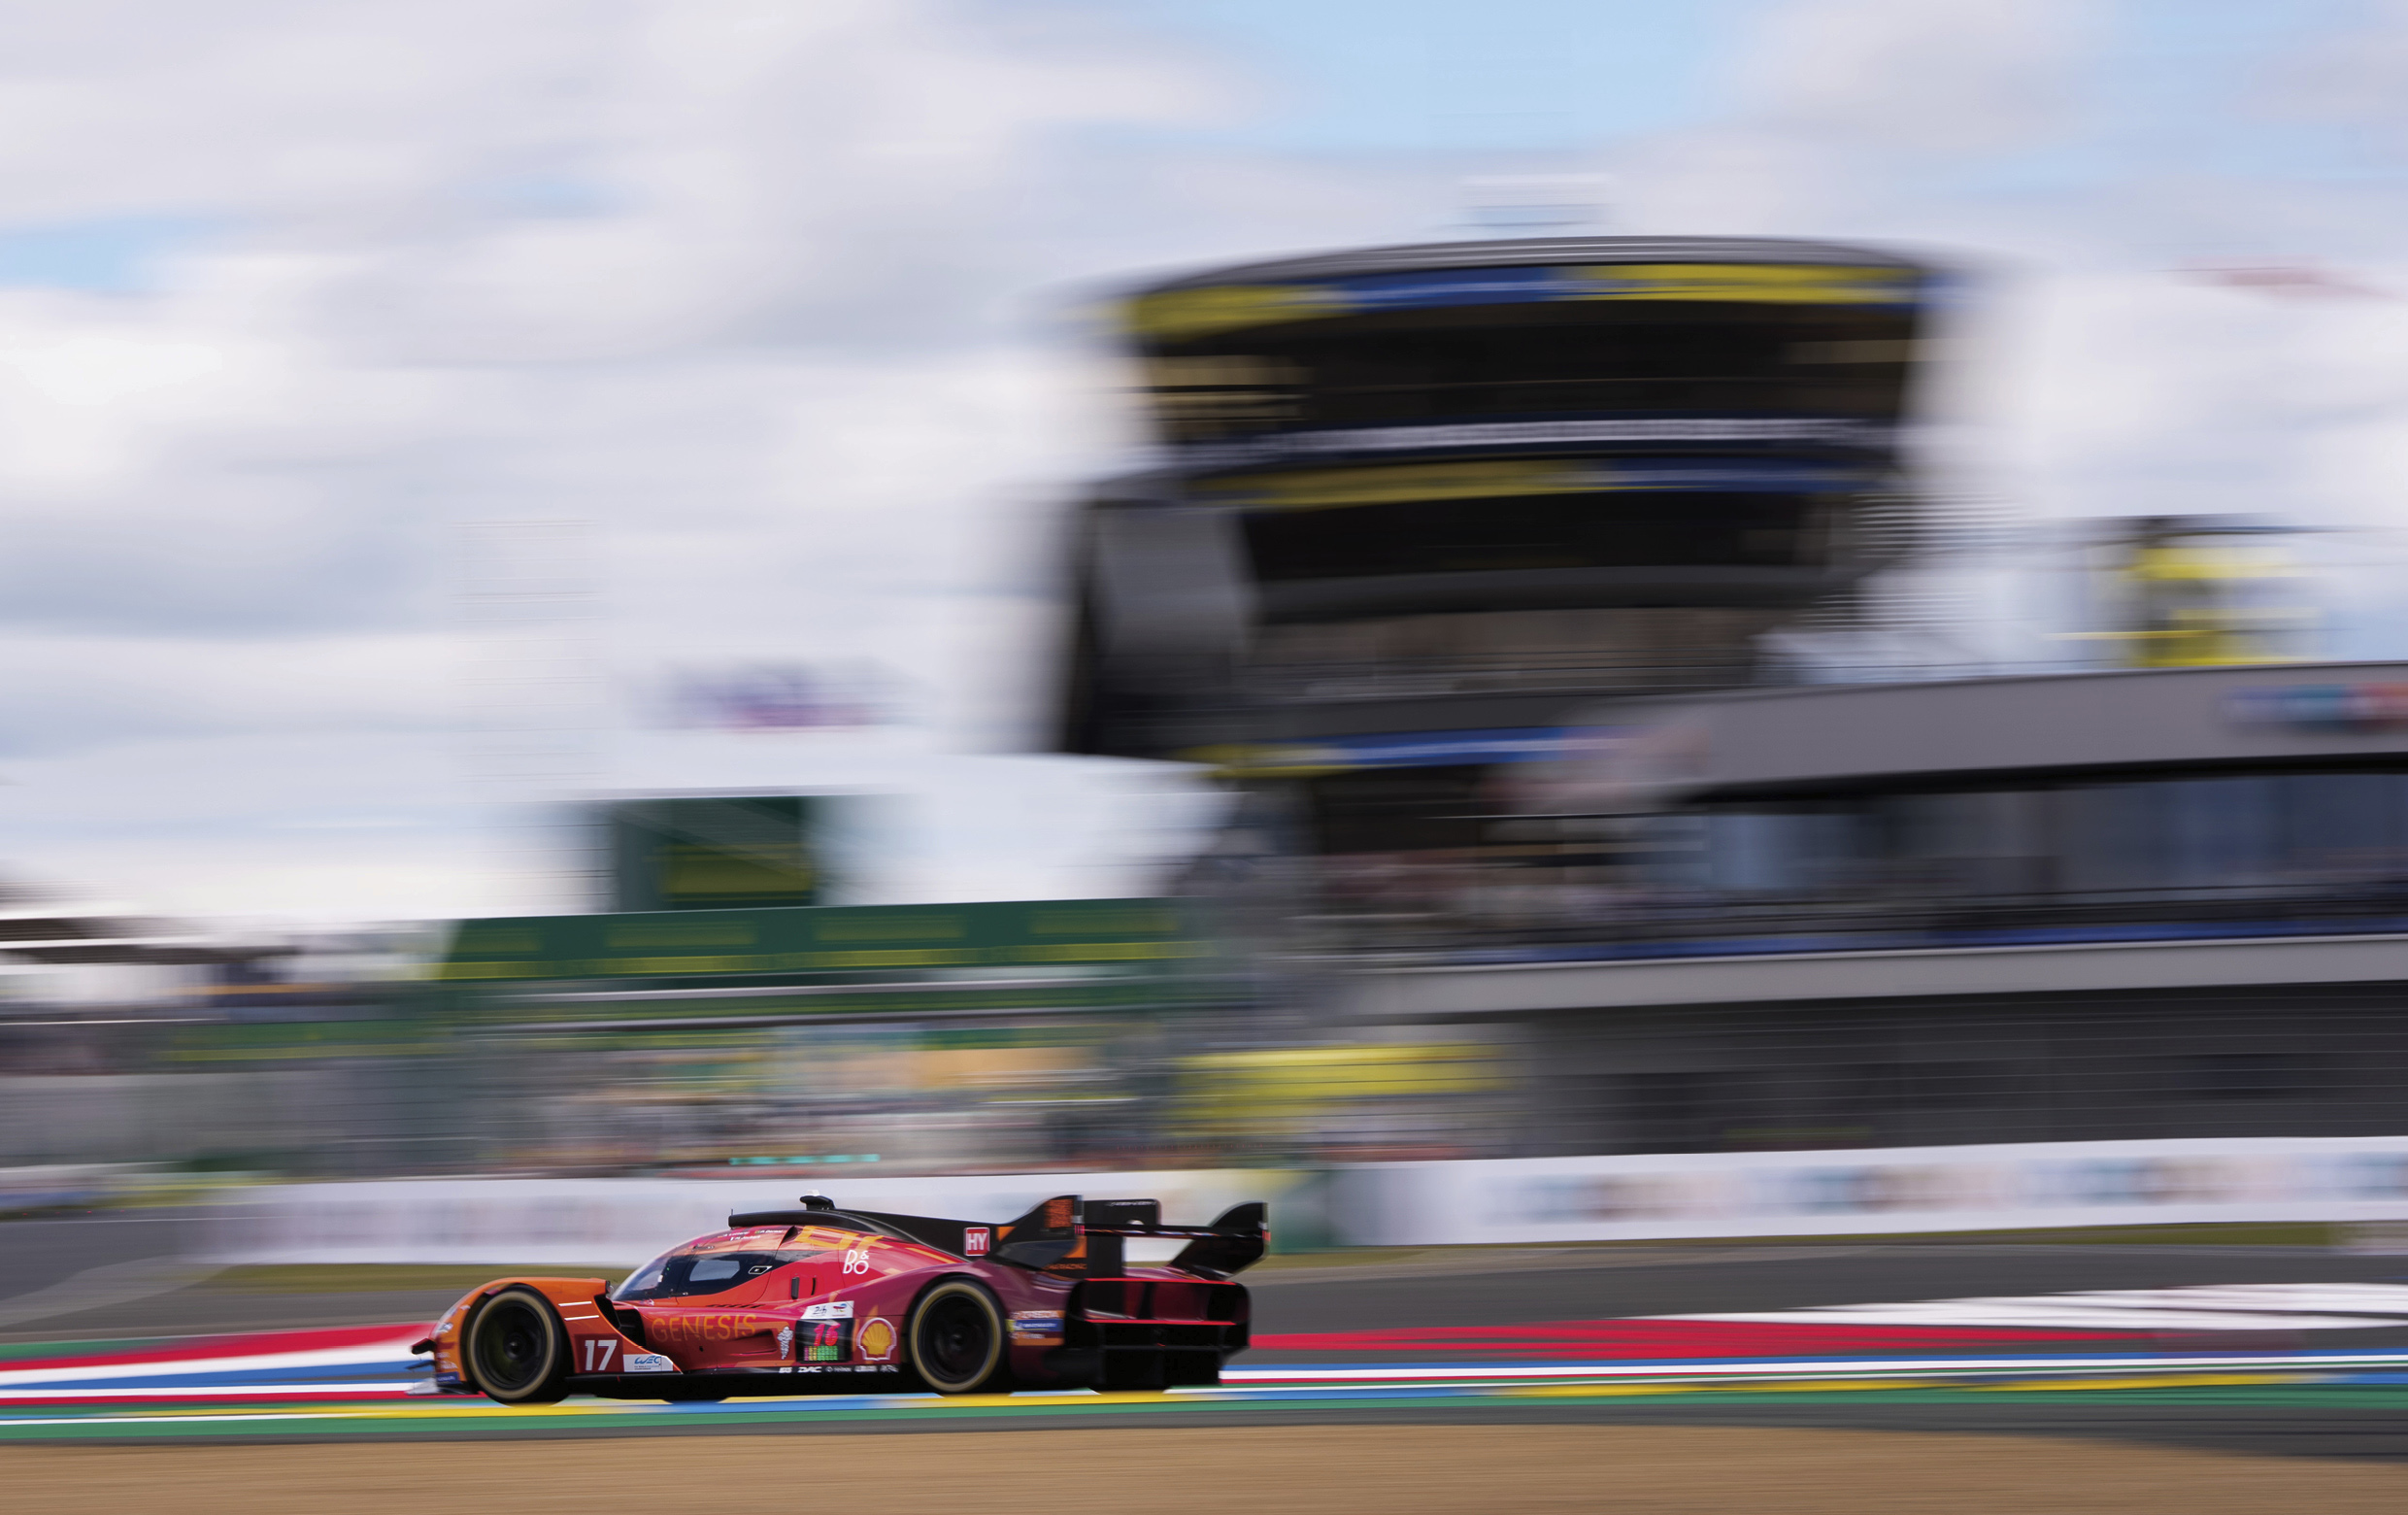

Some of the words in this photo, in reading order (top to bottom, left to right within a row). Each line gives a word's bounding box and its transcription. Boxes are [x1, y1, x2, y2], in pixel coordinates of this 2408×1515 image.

[966, 1232, 987, 1251] HY
[652, 1314, 757, 1342] GENESIS
[813, 1323, 842, 1347] 16
[585, 1339, 618, 1371] 17
[634, 1355, 662, 1364] WEC
